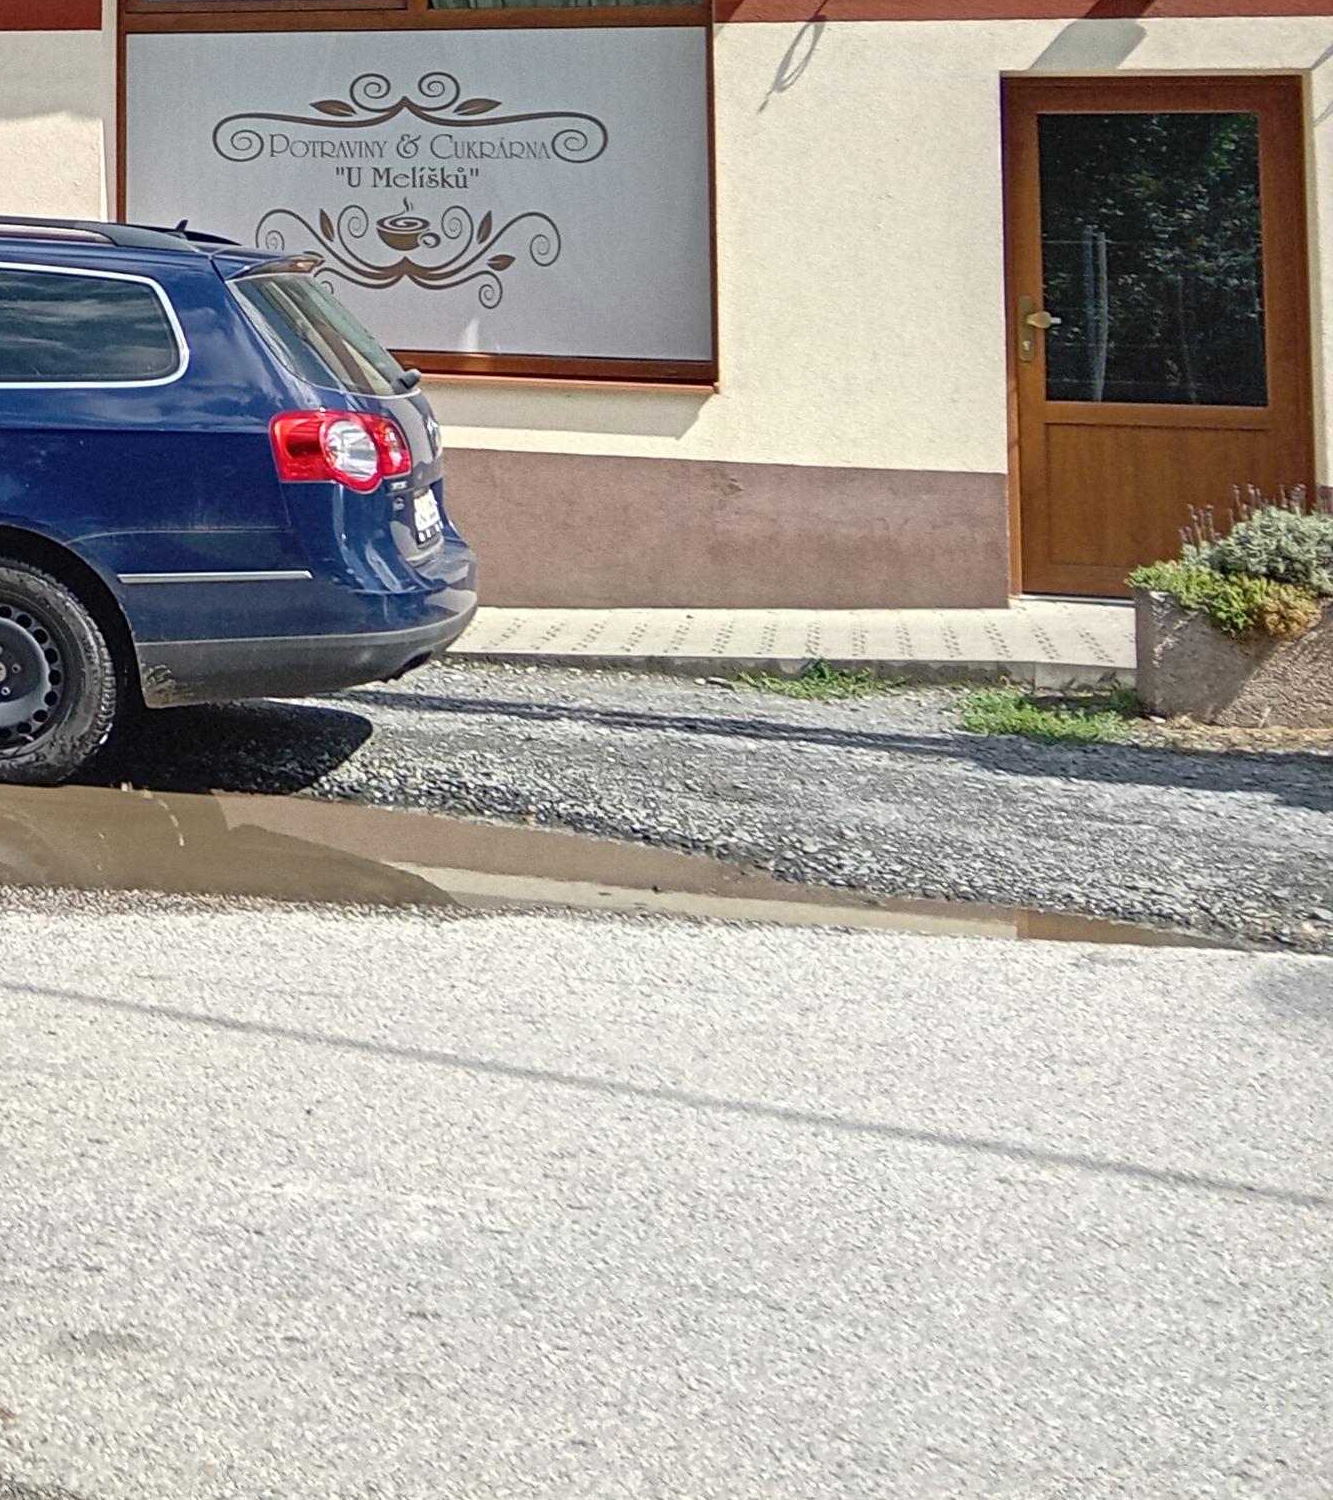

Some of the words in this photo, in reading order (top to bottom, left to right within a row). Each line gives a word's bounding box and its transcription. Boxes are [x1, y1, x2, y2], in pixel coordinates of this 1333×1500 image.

[396, 134, 421, 158] &
[335, 167, 362, 188] "U
[372, 167, 480, 189] Melíšků"
